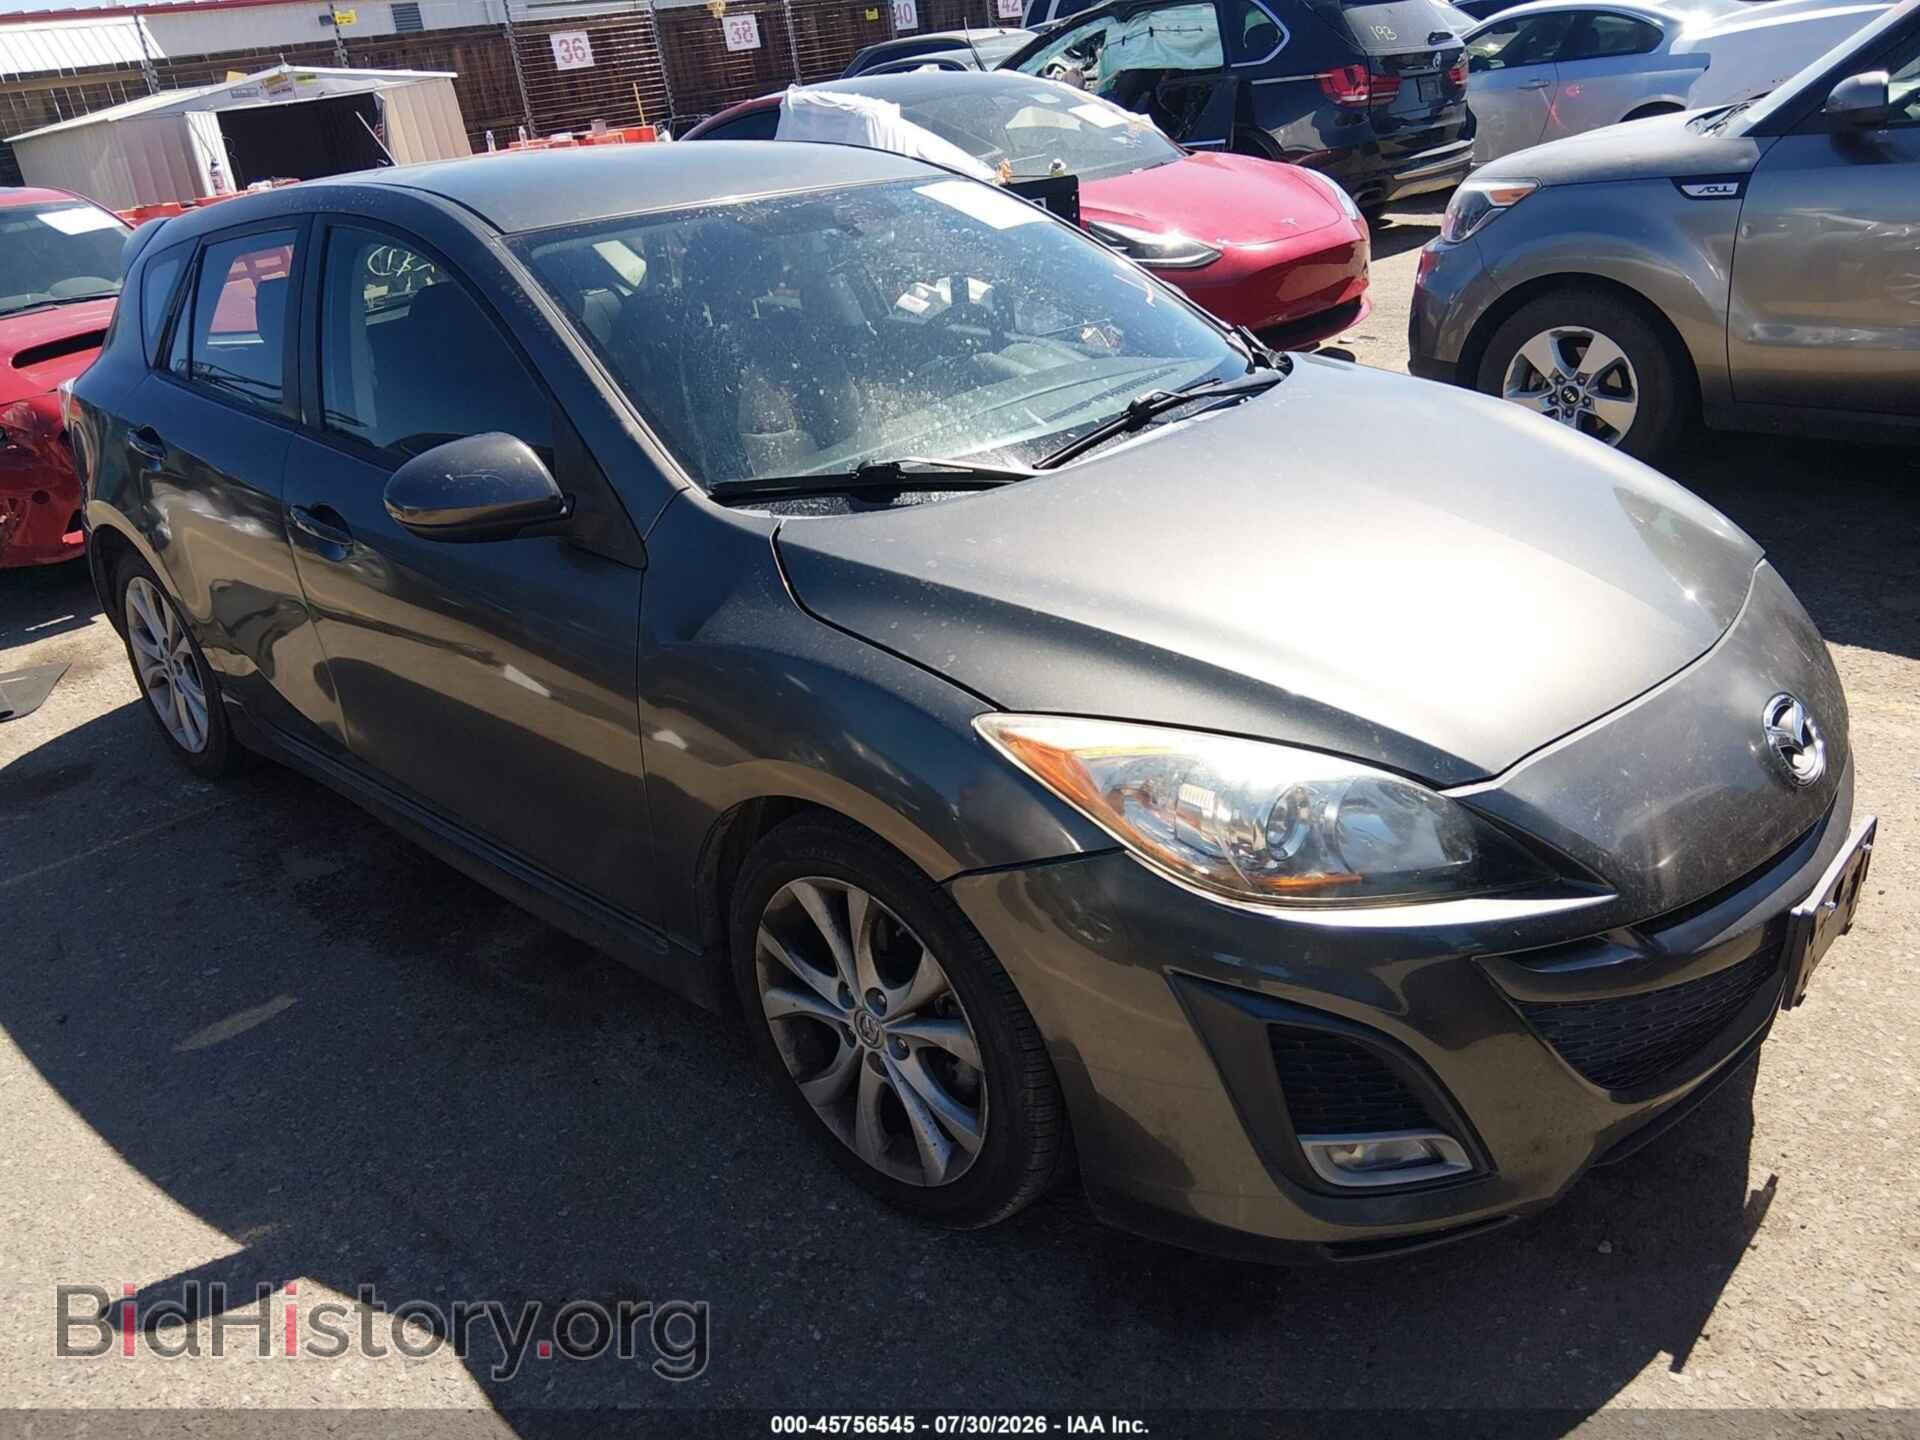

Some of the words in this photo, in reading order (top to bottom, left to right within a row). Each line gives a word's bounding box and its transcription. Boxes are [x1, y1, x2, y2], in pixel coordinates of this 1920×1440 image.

[895, 3, 913, 25] 40
[1001, 0, 1019, 13] 42
[730, 20, 753, 44] 38
[1369, 25, 1398, 40] 193
[559, 37, 585, 63] 36
